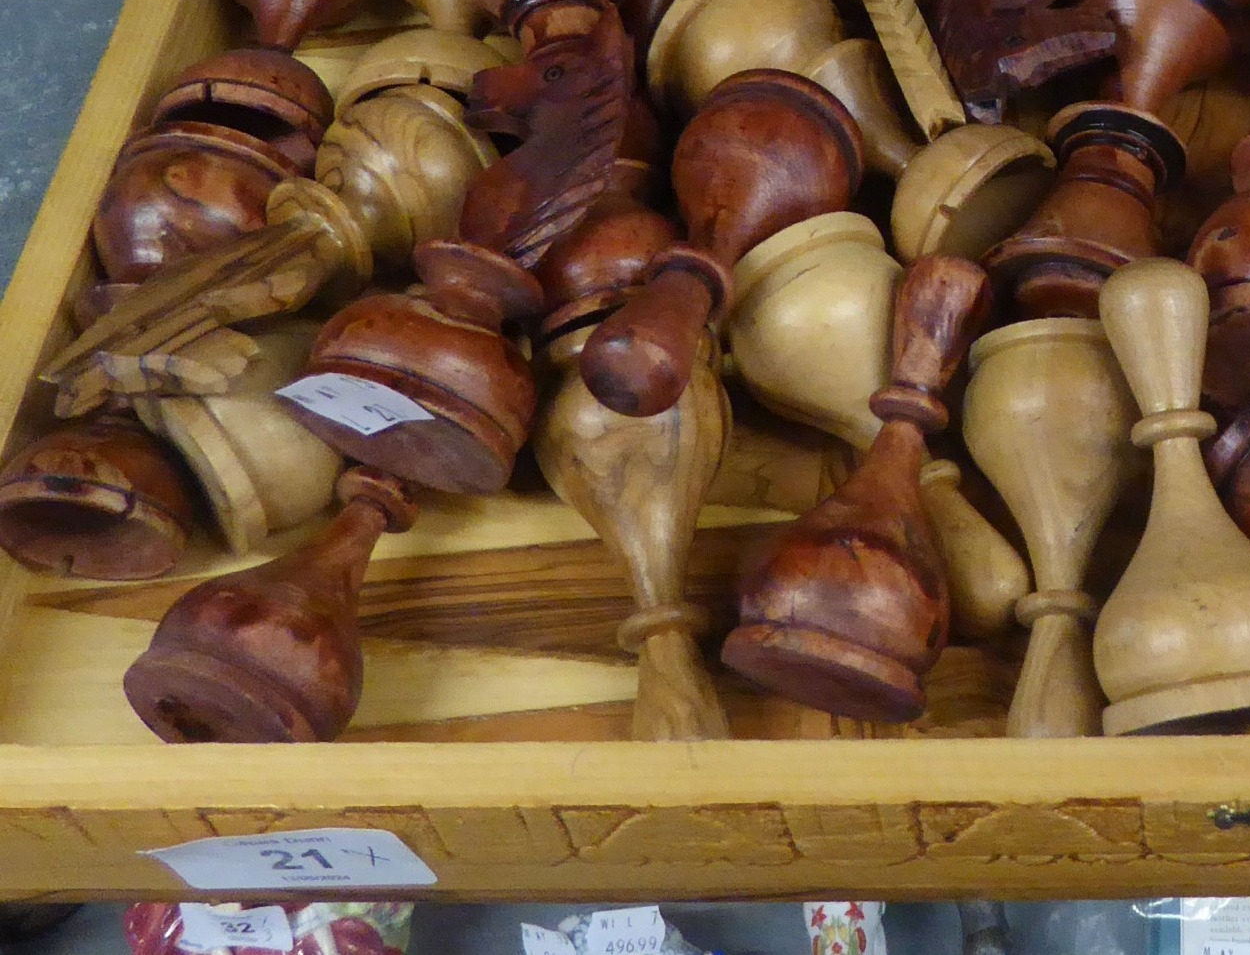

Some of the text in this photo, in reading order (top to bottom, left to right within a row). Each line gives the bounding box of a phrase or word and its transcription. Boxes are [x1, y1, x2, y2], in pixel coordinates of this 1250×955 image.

[261, 848, 334, 870] 21
[219, 920, 256, 935] 32
[605, 936, 658, 955] 49699
